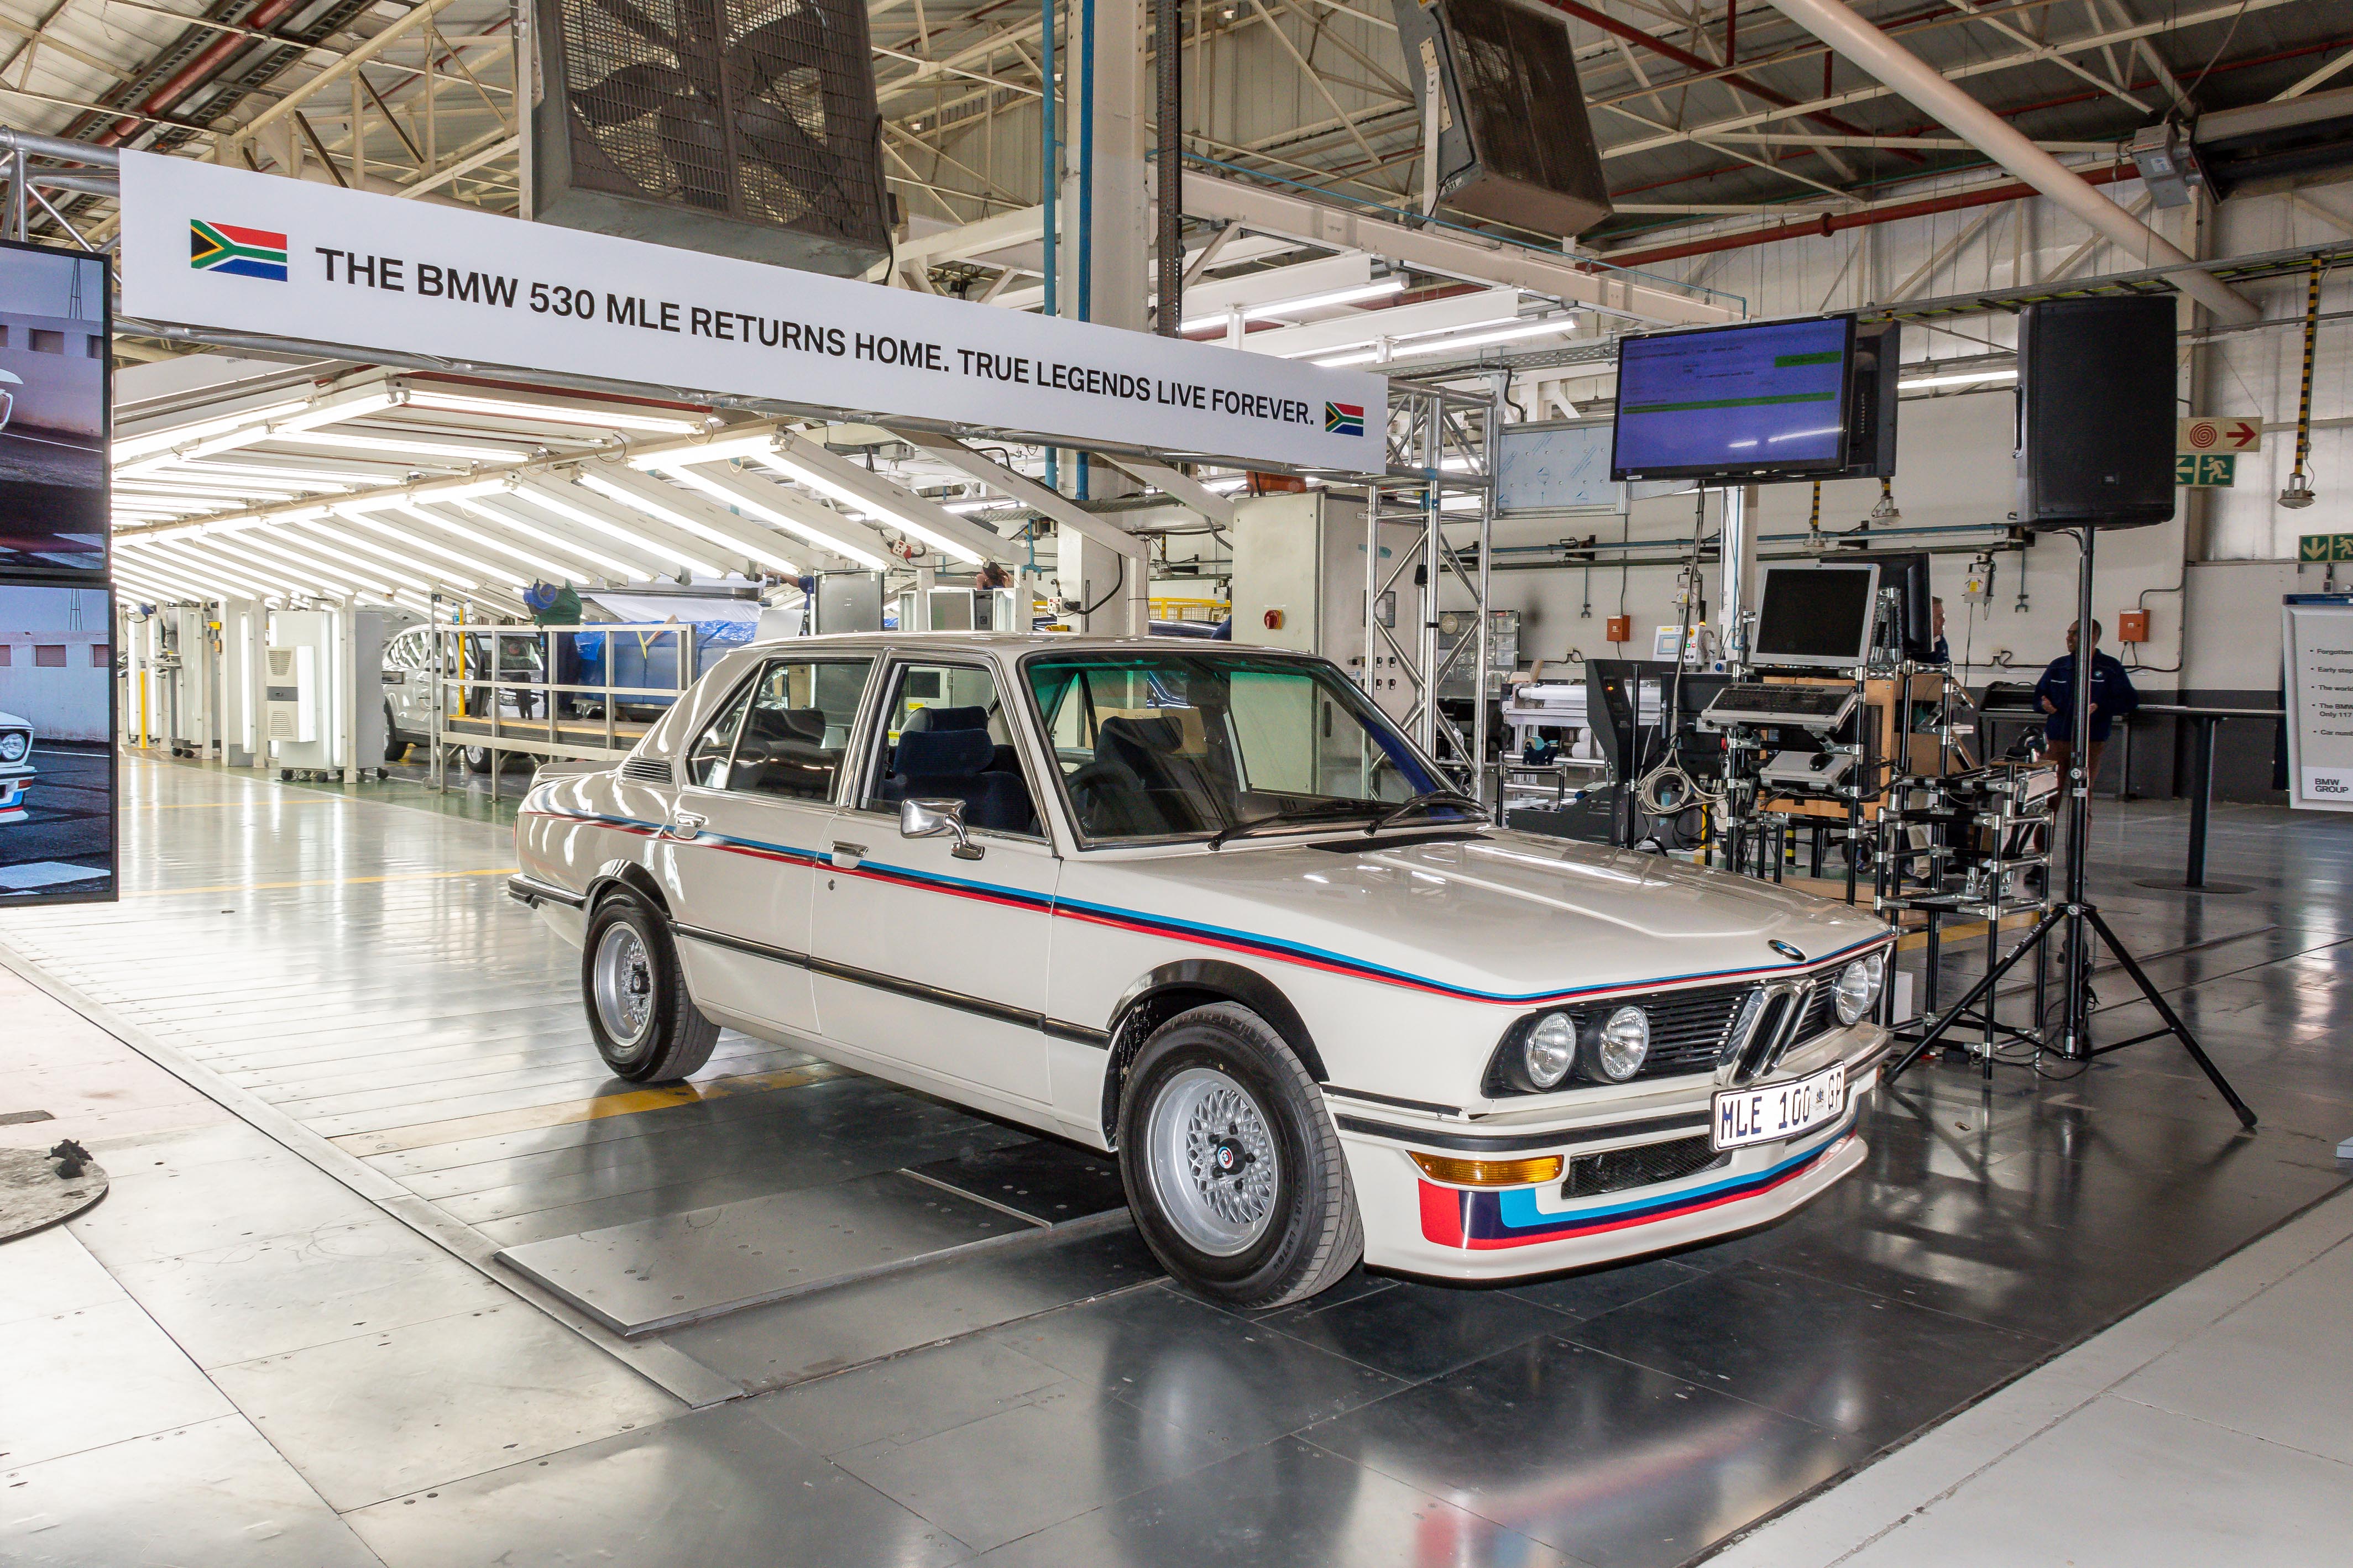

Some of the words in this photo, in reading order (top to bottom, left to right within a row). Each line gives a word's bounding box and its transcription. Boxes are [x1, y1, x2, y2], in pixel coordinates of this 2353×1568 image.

[315, 247, 404, 292] THE
[417, 263, 519, 308] BMW
[529, 282, 595, 319] 530
[606, 293, 681, 333] MLE
[691, 307, 846, 356] RETURNS
[855, 332, 949, 372] HOME.
[957, 348, 1029, 384] TRUE
[1037, 361, 1151, 401] LEGENDS
[1158, 380, 1206, 410] LIVE
[1212, 389, 1313, 425] FOREVER.
[1721, 1096, 1762, 1140] MLE
[1779, 1085, 1810, 1130] 100
[1828, 1072, 1842, 1111] GP
